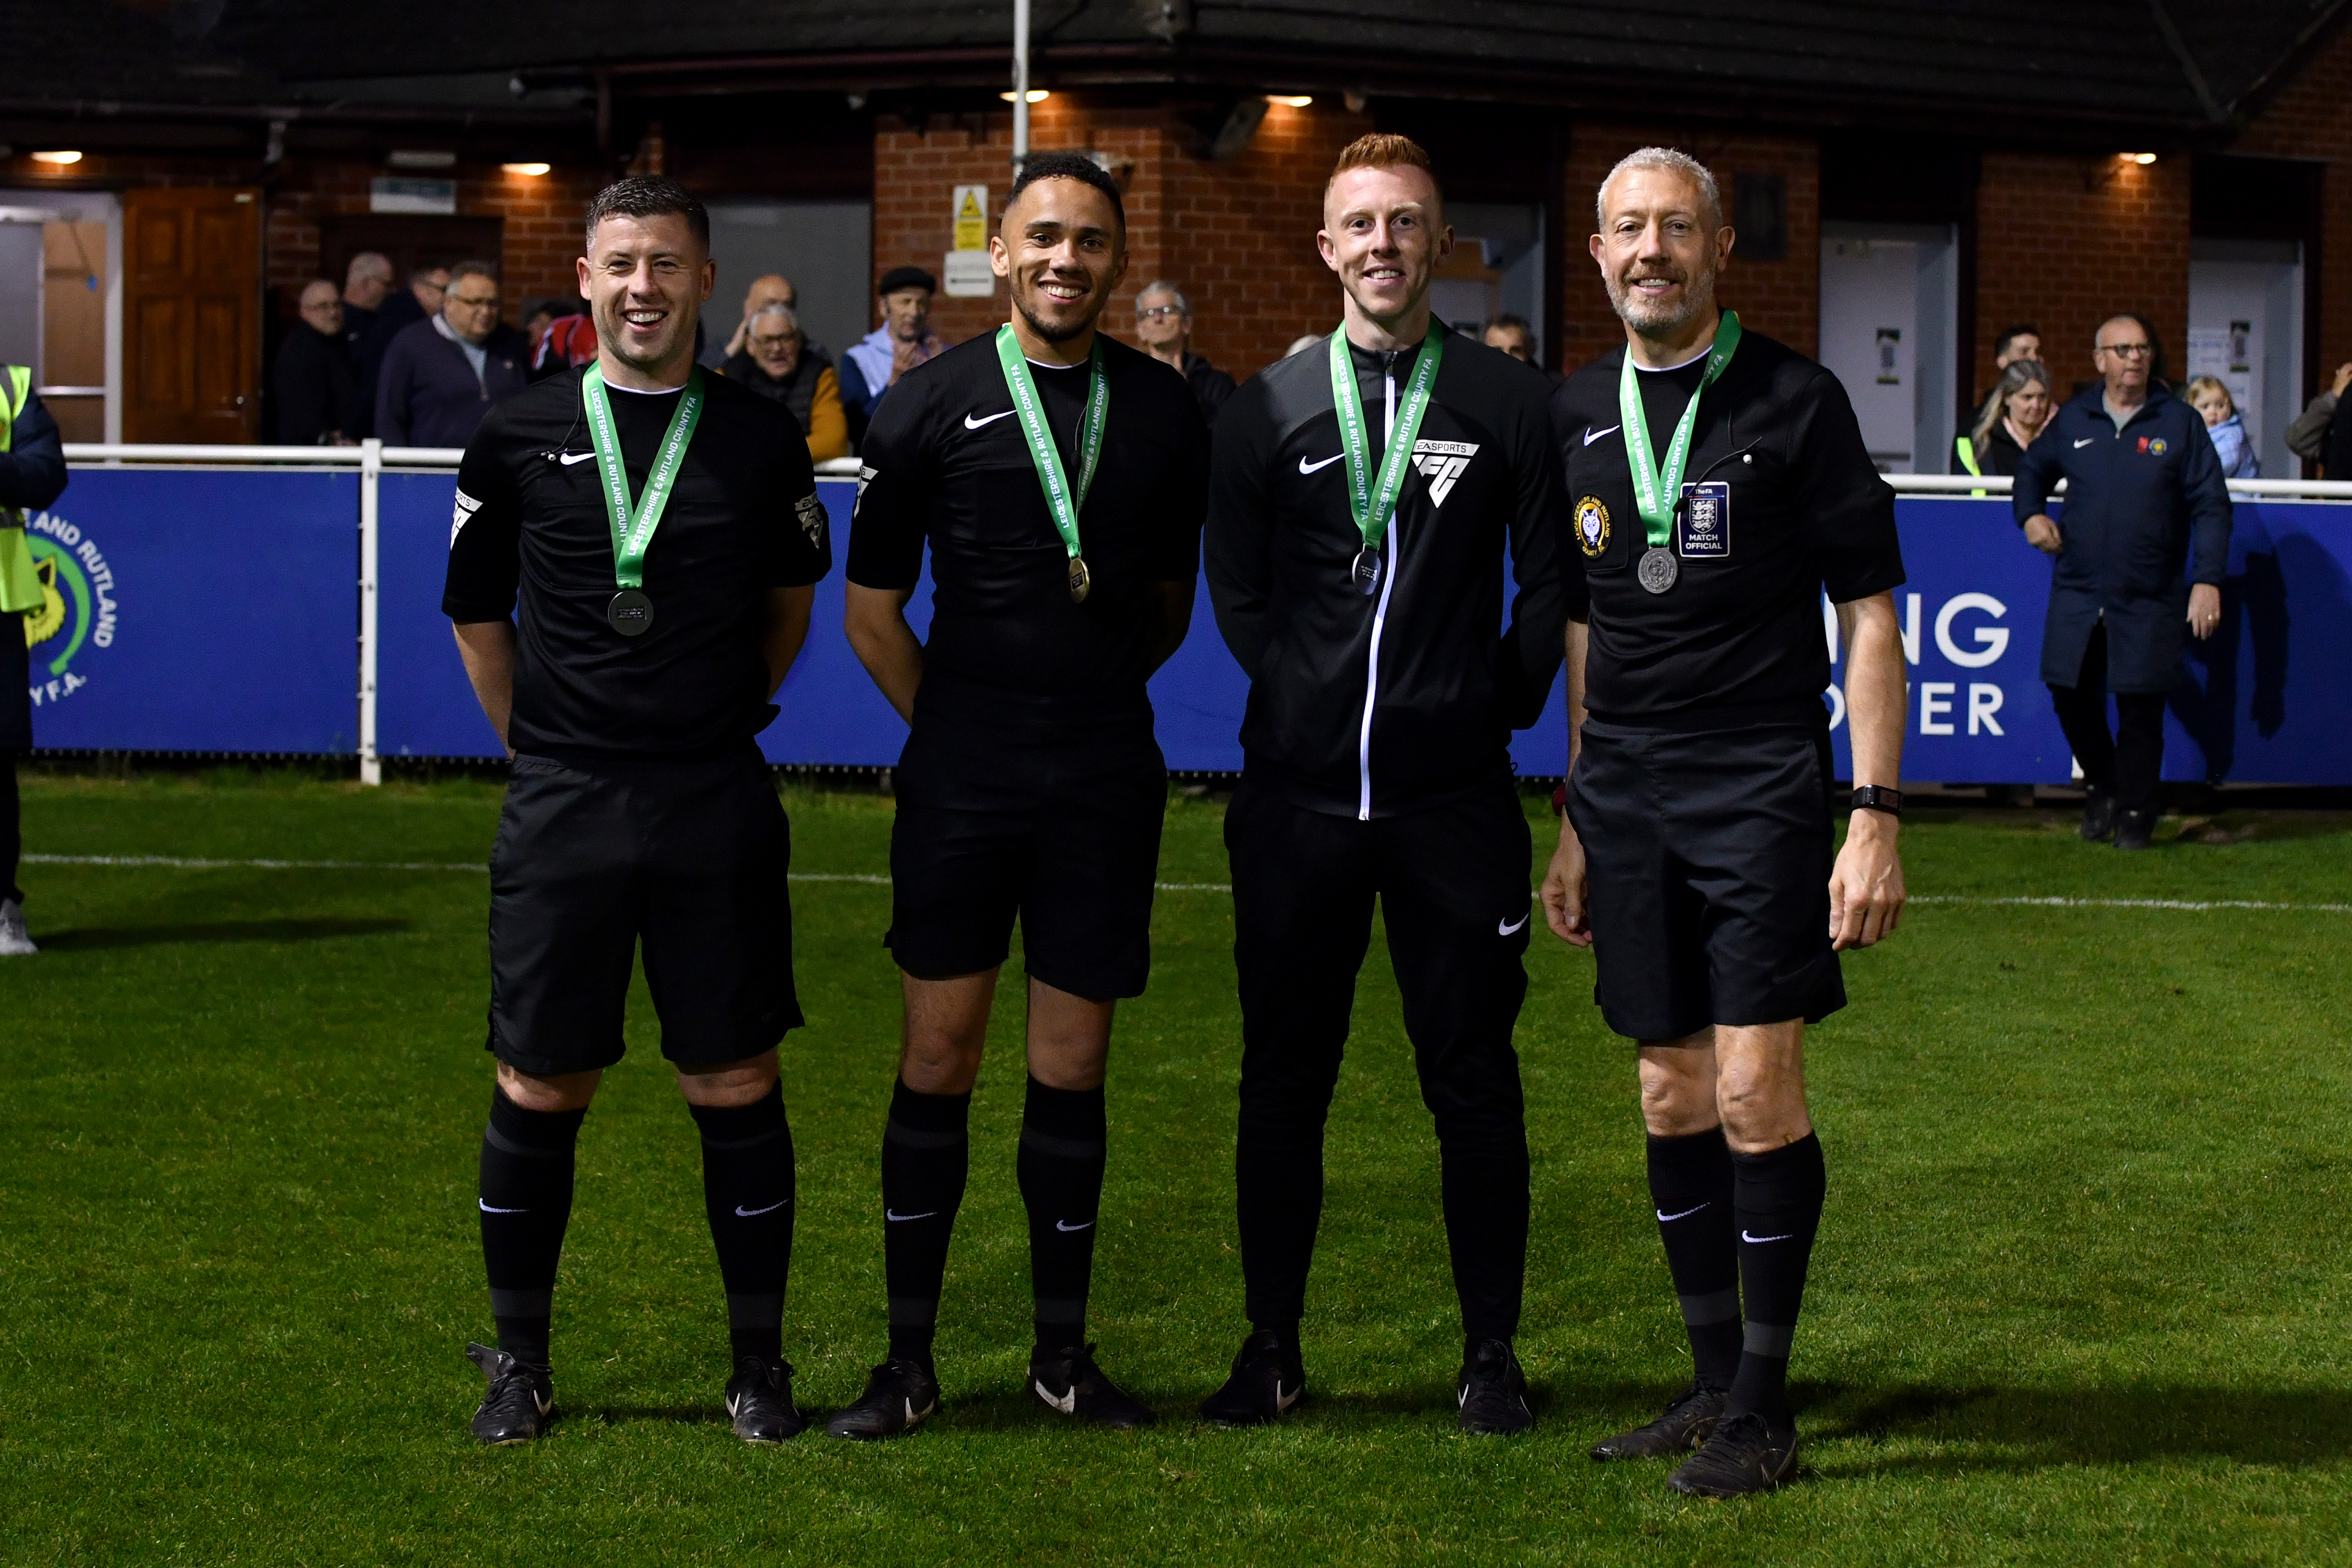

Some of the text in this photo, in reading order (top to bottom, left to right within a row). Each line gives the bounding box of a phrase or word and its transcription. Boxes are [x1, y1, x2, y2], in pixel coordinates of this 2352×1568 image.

[1011, 364, 1021, 376] FA
[1714, 355, 1723, 366] FA
[1014, 377, 1032, 410] COUNTY
[1337, 354, 1355, 419] LEICESTERSHIRE
[1026, 411, 1046, 449] RUTLAND
[1089, 406, 1101, 446] RUTLAND
[1096, 373, 1105, 406] COUNTY
[1627, 400, 1641, 440] RUTLAND
[591, 387, 613, 454] LEICESTERSHIRE
[608, 464, 623, 505] RUTLAND
[1349, 428, 1363, 468] RUTLAND
[1374, 451, 1402, 522] LEICESTERSHIRE
[1398, 403, 1417, 443] RUTLAND
[1411, 368, 1428, 403] COUNTY
[1423, 359, 1433, 370] FA
[1671, 424, 1688, 466] RUTLAND
[628, 489, 660, 556] LEICESTERSHIRE
[657, 442, 678, 482] RUTLAND
[673, 407, 692, 442] COUNTY
[687, 397, 696, 408] FA
[1043, 458, 1070, 528] LEICESTERSHIRE
[1356, 470, 1367, 506] COUNTY
[1635, 447, 1657, 514] LEICESTERSHIRE
[1663, 467, 1677, 504] COUNTY
[1360, 509, 1368, 520] FA
[1591, 497, 1601, 507] AND
[1601, 505, 1610, 538] RUTLAND
[33, 511, 117, 648] AND RUTLAND
